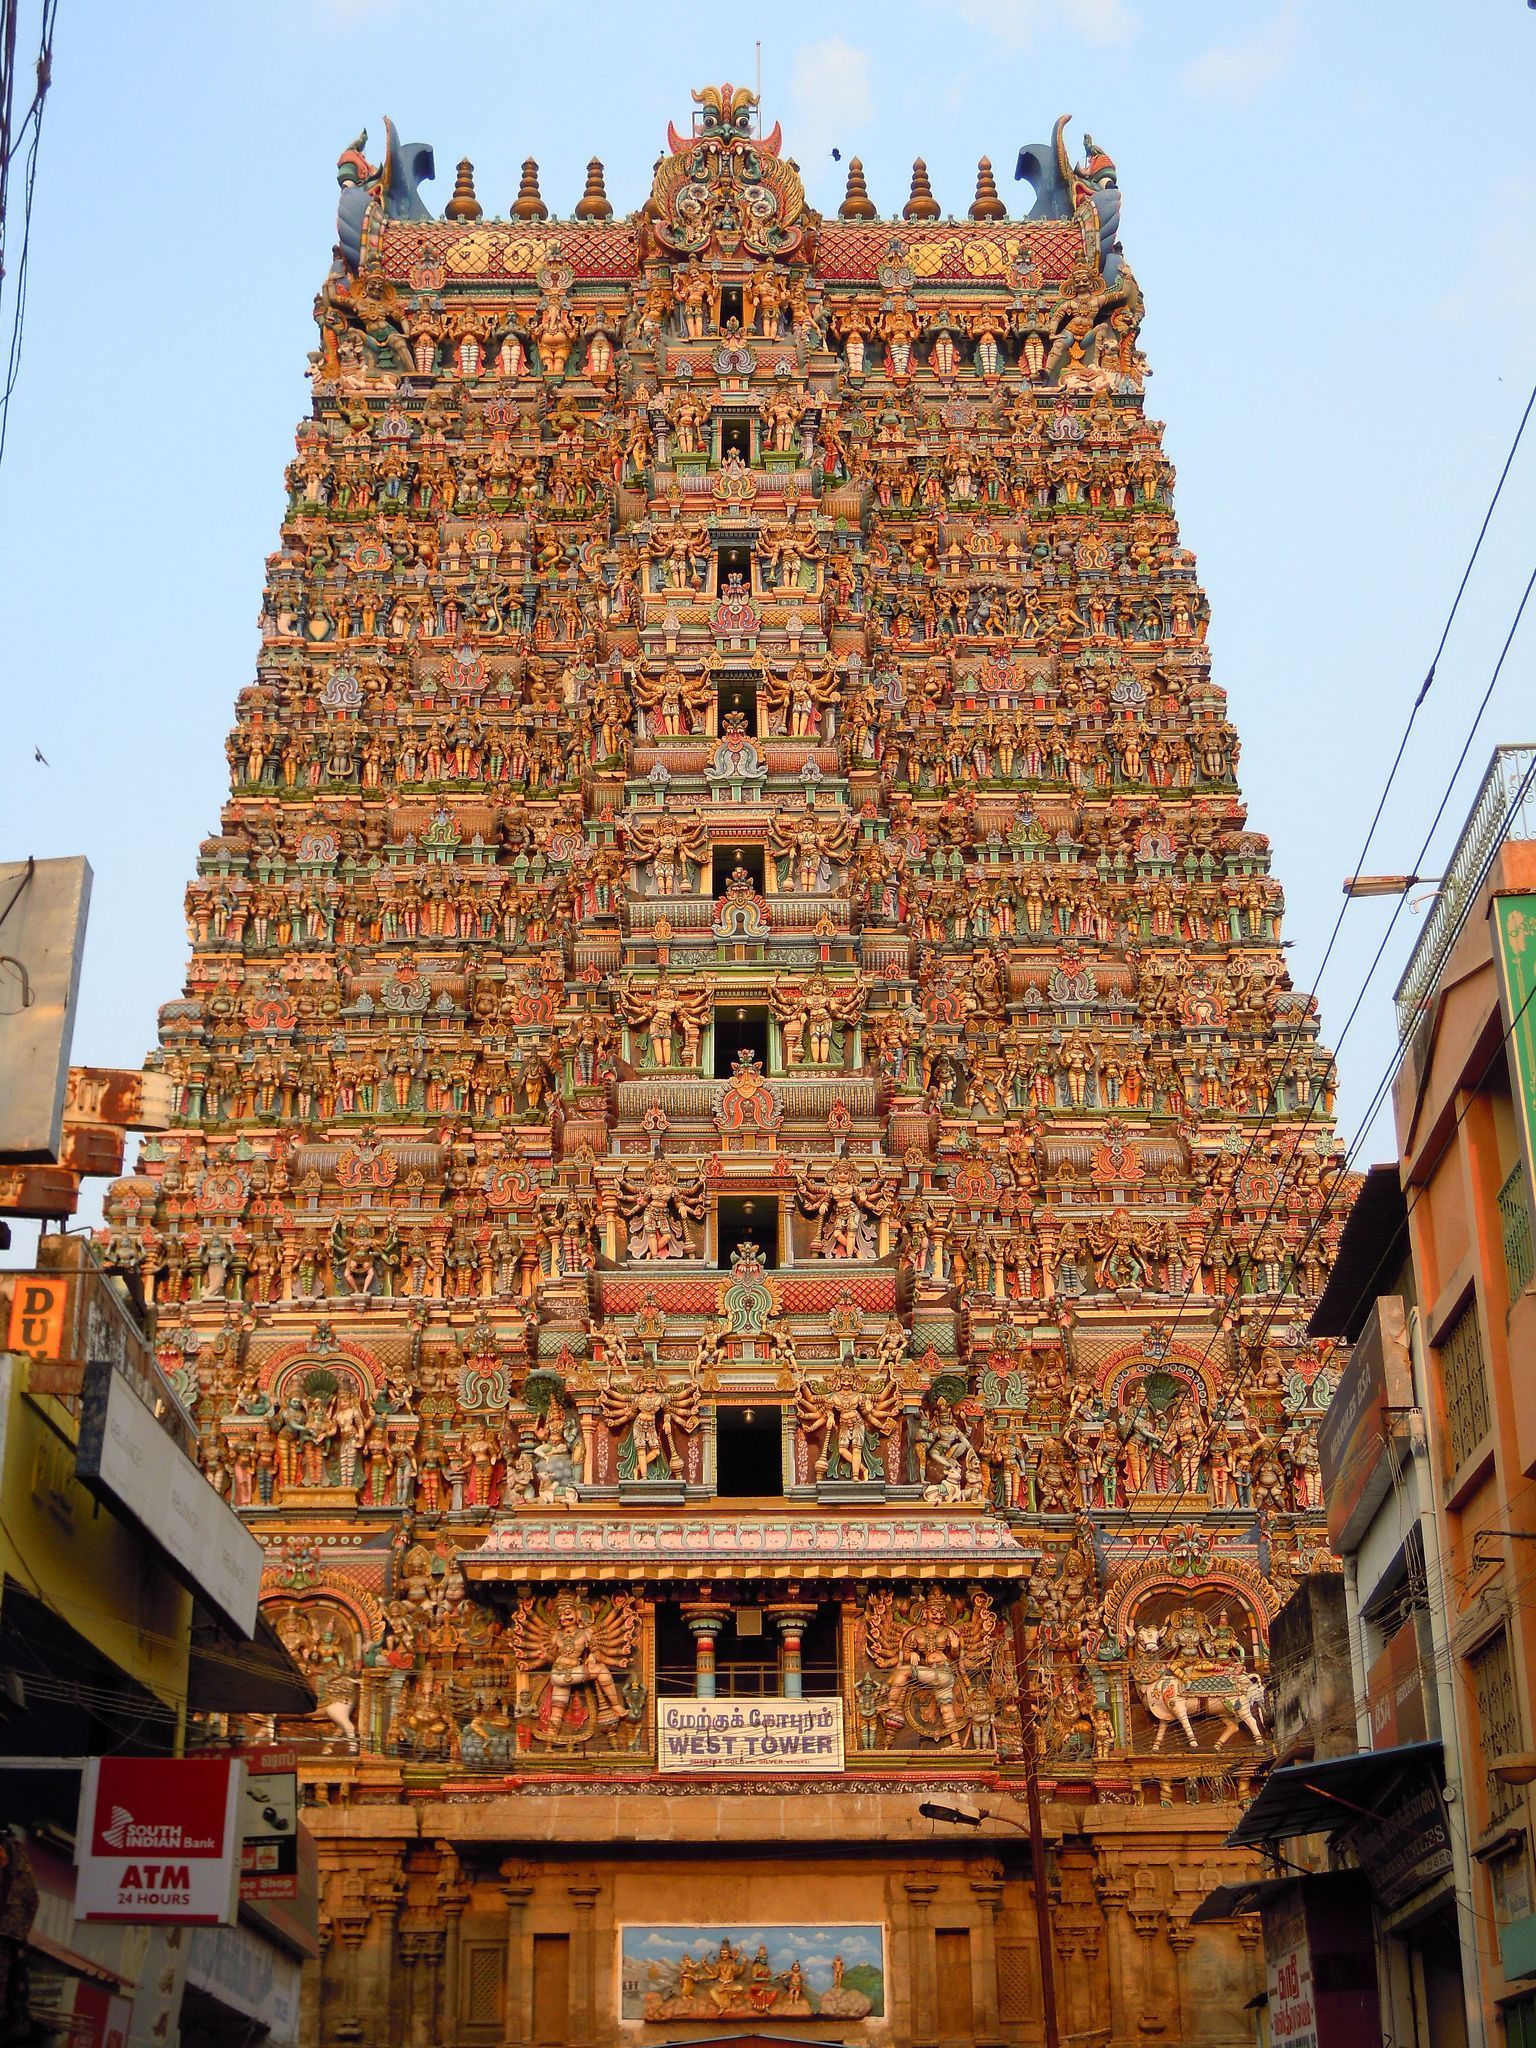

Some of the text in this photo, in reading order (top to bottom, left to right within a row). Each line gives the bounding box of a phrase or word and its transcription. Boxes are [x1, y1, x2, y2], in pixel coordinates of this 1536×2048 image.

[21, 1287, 54, 1358] DU
[1357, 1362, 1372, 1406] BSA
[667, 1707, 833, 1734] மேற்குக் கோபுரம்
[1375, 1692, 1391, 1734] BSA
[668, 1736, 833, 1755] WEST TOWER
[127, 1825, 182, 1836] SOUTH
[126, 1836, 216, 1849] INDIAN Bank
[119, 1865, 190, 1889] ATM
[240, 1878, 293, 1889] oe Shop
[118, 1893, 190, 1905] 24 HOURS
